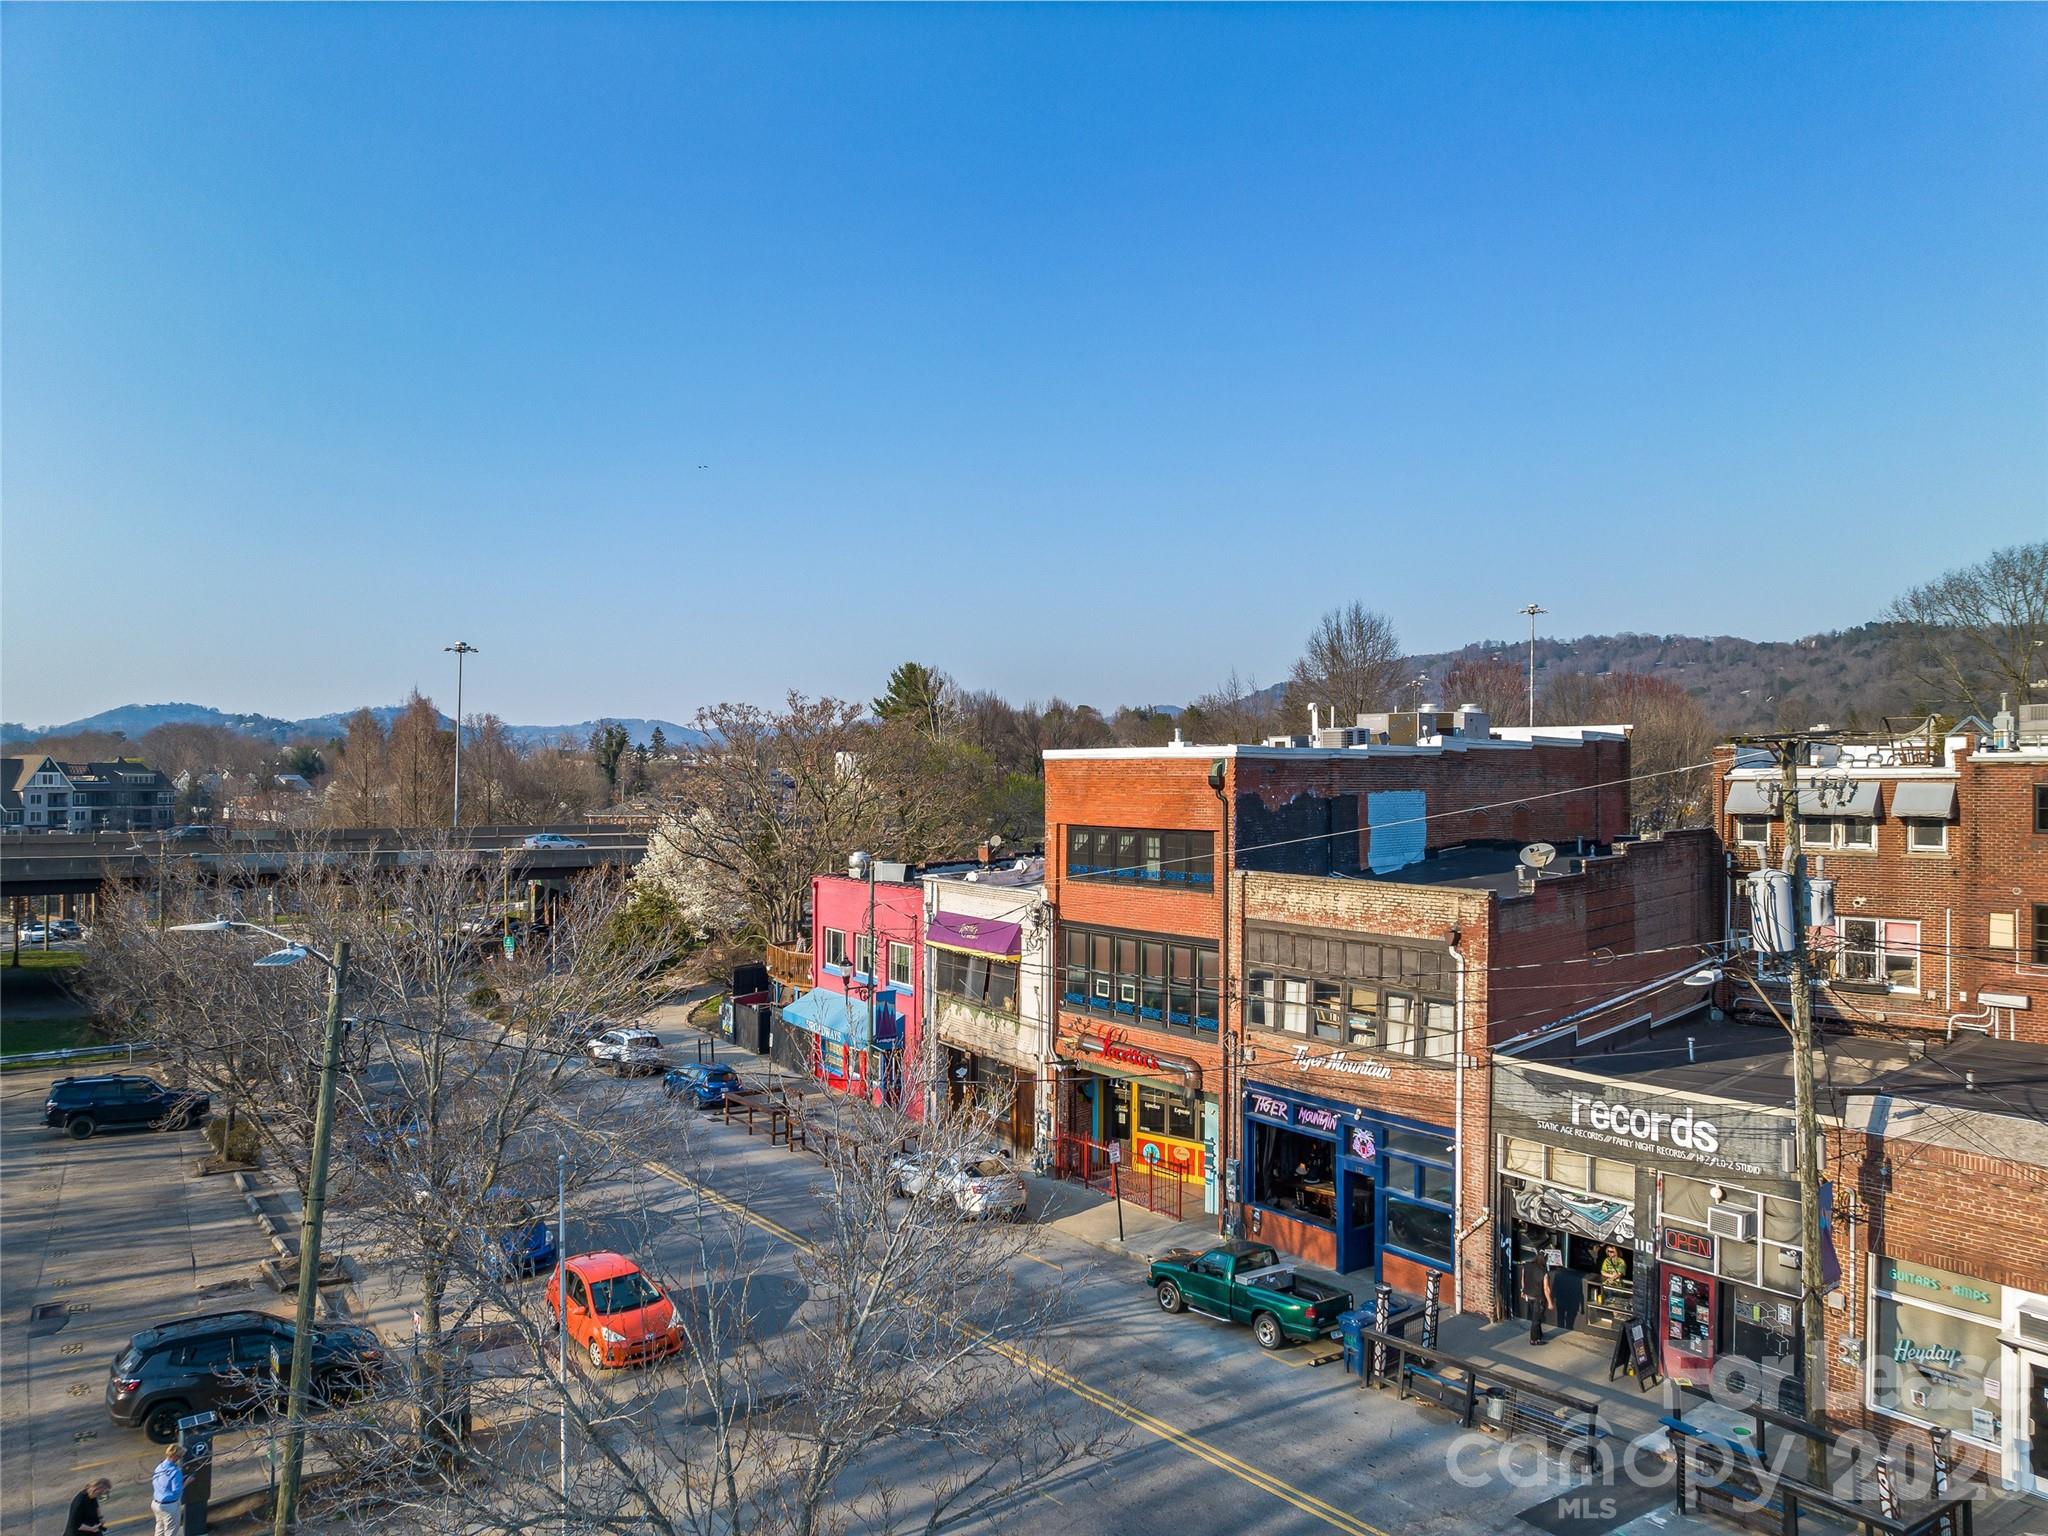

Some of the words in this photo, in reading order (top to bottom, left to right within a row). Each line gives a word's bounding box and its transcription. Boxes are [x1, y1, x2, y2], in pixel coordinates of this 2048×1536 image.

[1291, 1045, 1327, 1072] Tiger
[1326, 1051, 1392, 1079] Mountain
[1252, 1094, 1288, 1120] TIGER
[1571, 1096, 1719, 1153] records
[1537, 1120, 1559, 1132] STATIC
[1560, 1125, 1573, 1136] AGE
[1574, 1128, 1604, 1142] RECORDS
[1612, 1136, 1634, 1148] FAMILY
[1634, 1140, 1655, 1152] NIGHT
[1656, 1145, 1686, 1160] RECORDS
[1735, 1162, 1761, 1175] STUDIO
[1634, 1238, 1654, 1254] 110
[1667, 1230, 1711, 1258] OPEN
[1889, 1268, 1941, 1292] GUITARS
[1952, 1285, 1991, 1304] AMPS
[1894, 1339, 1962, 1369] Heyday
